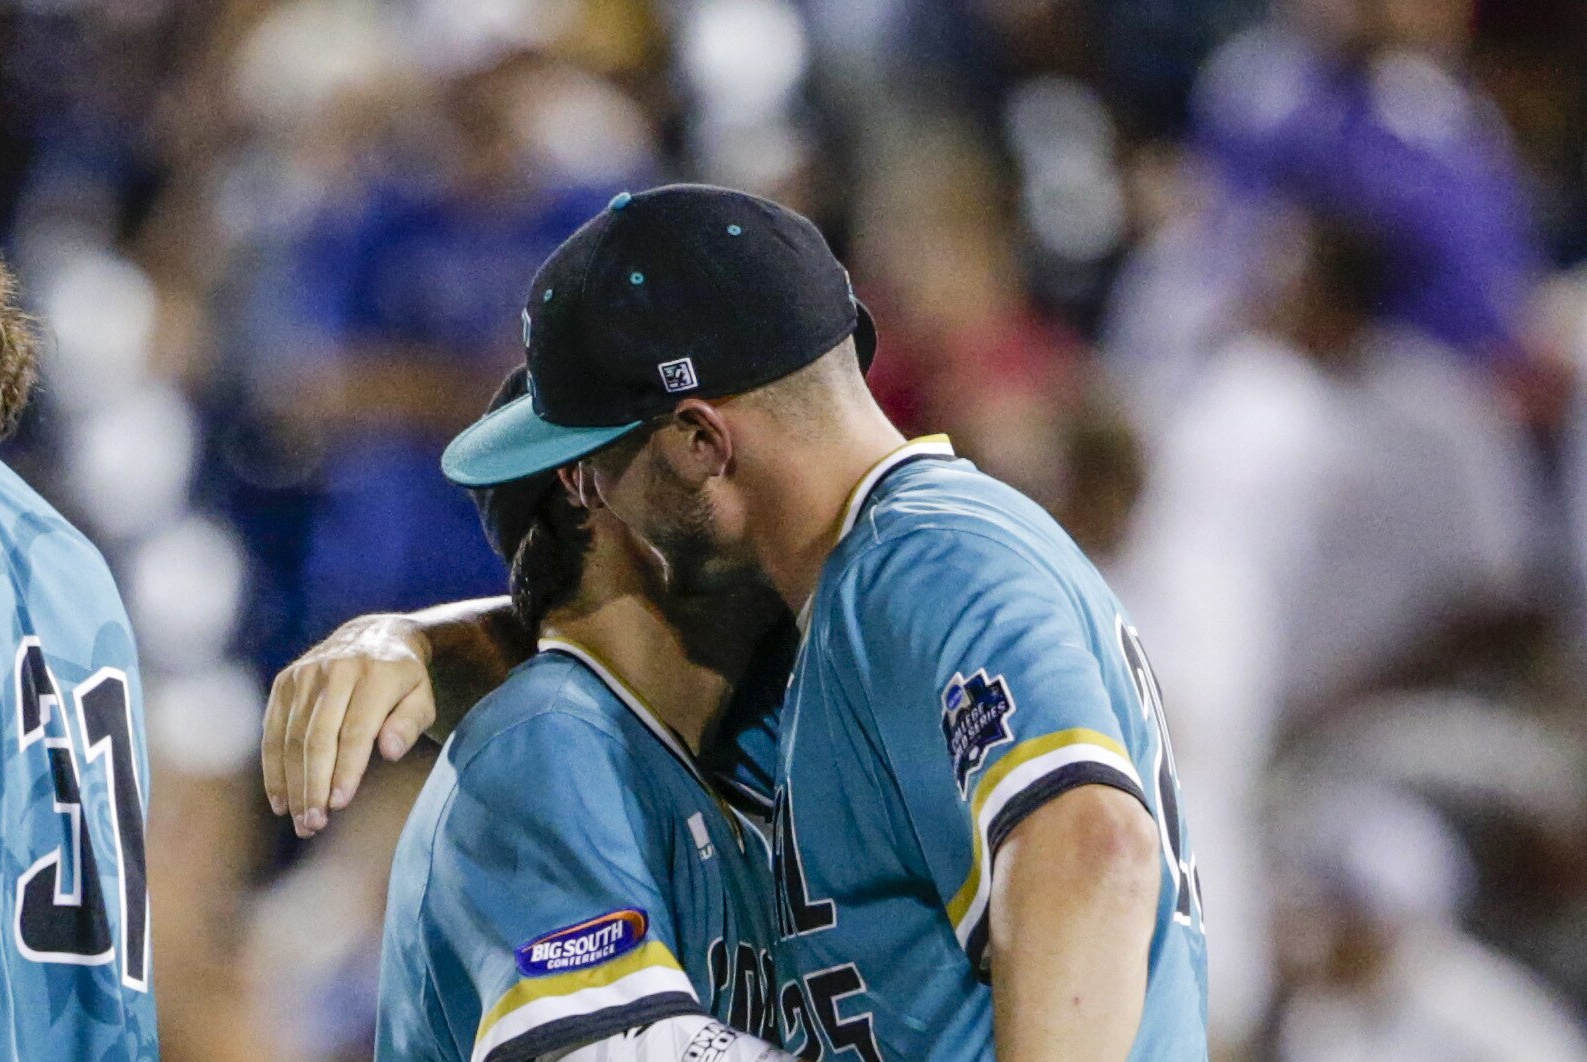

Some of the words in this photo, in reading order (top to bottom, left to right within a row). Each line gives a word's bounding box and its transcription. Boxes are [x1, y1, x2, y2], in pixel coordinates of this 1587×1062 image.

[15, 634, 149, 993] 31
[530, 942, 563, 962] BIG
[562, 919, 624, 957] SOUTH
[546, 943, 615, 970] CONFERENCE
